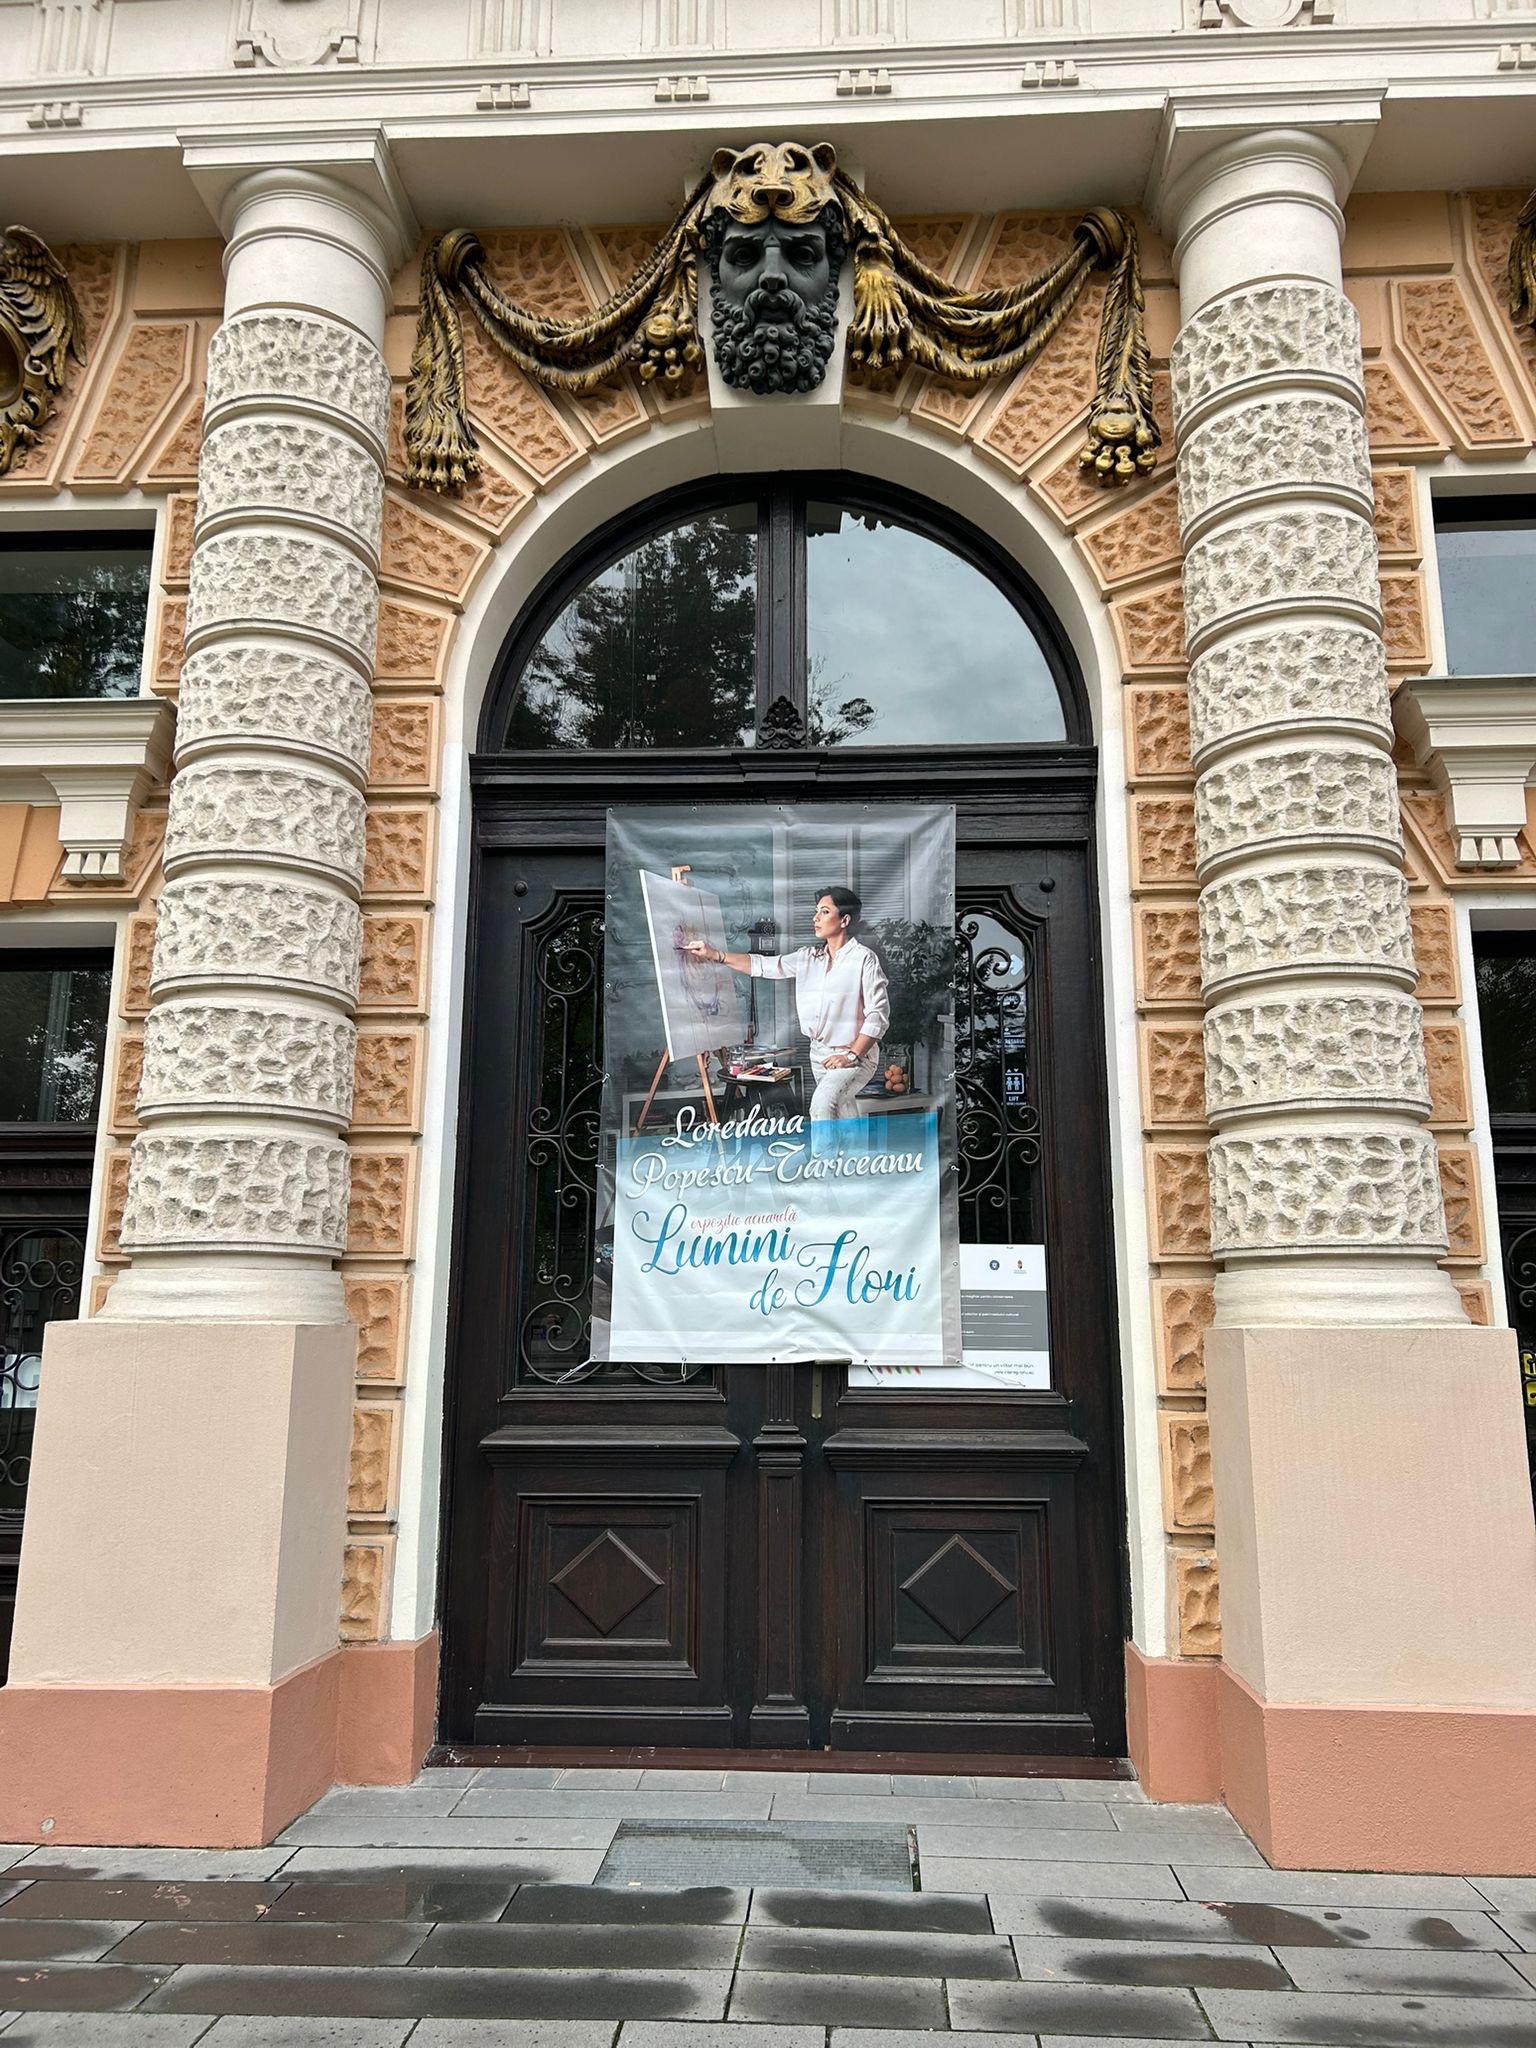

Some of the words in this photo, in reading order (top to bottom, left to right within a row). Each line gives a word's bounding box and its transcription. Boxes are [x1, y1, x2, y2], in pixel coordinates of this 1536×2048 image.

[661, 1103, 805, 1148] Loredana
[626, 1141, 925, 1200] Popescu-Tăriceanu
[631, 1203, 799, 1275] Lumini
[749, 1268, 788, 1317] de
[794, 1229, 922, 1308] Flori
